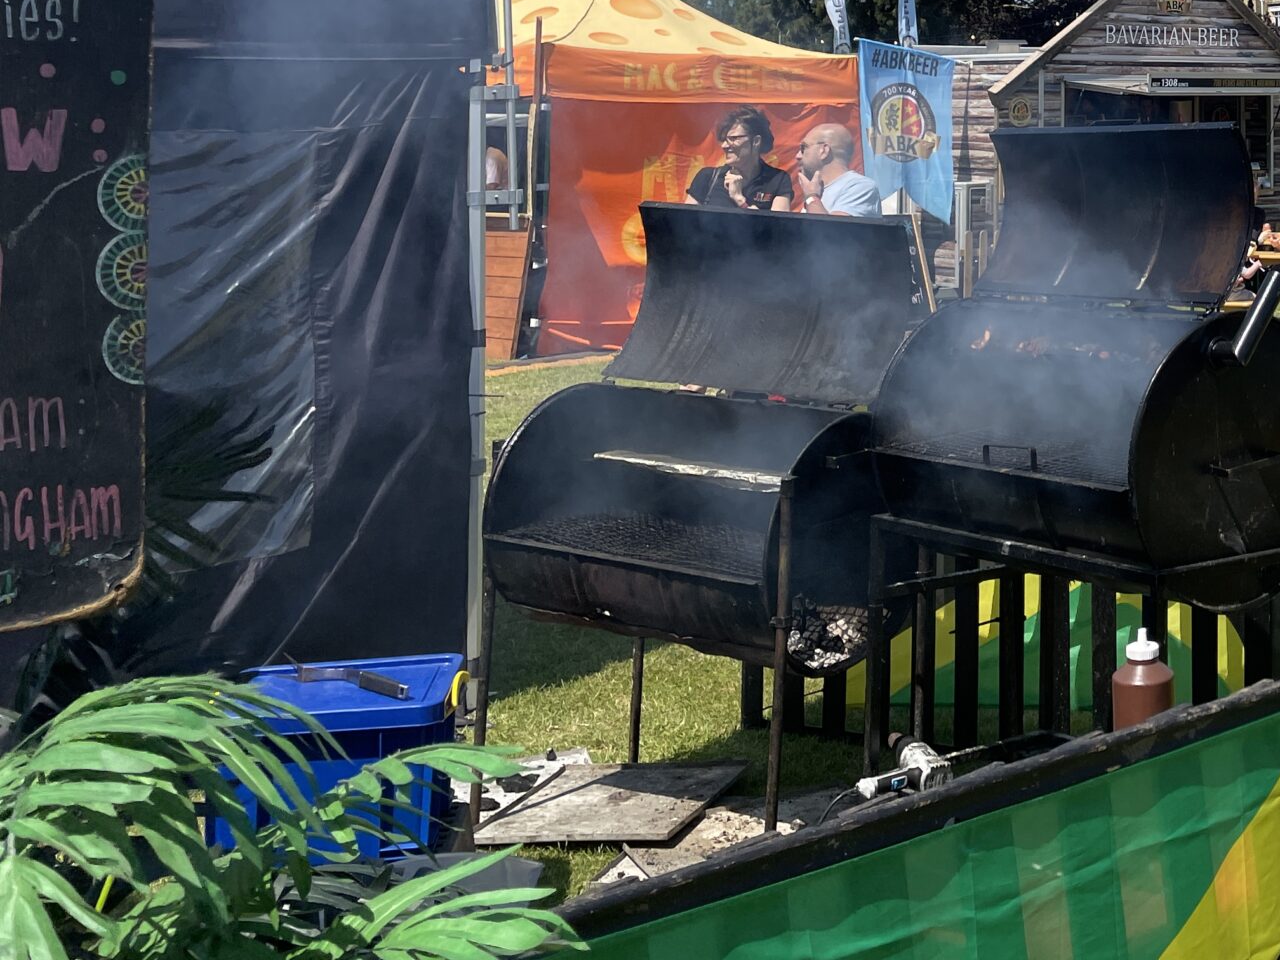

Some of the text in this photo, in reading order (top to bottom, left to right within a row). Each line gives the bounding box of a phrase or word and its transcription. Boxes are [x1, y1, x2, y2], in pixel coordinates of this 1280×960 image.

[1166, 0, 1184, 11] ABK
[1105, 24, 1240, 47] BAVARIAN BEER
[871, 48, 939, 77] #ABKBEER
[623, 62, 680, 91] MAC
[1161, 78, 1178, 87] 1308
[882, 86, 897, 98] 700
[884, 135, 918, 155] ABK
